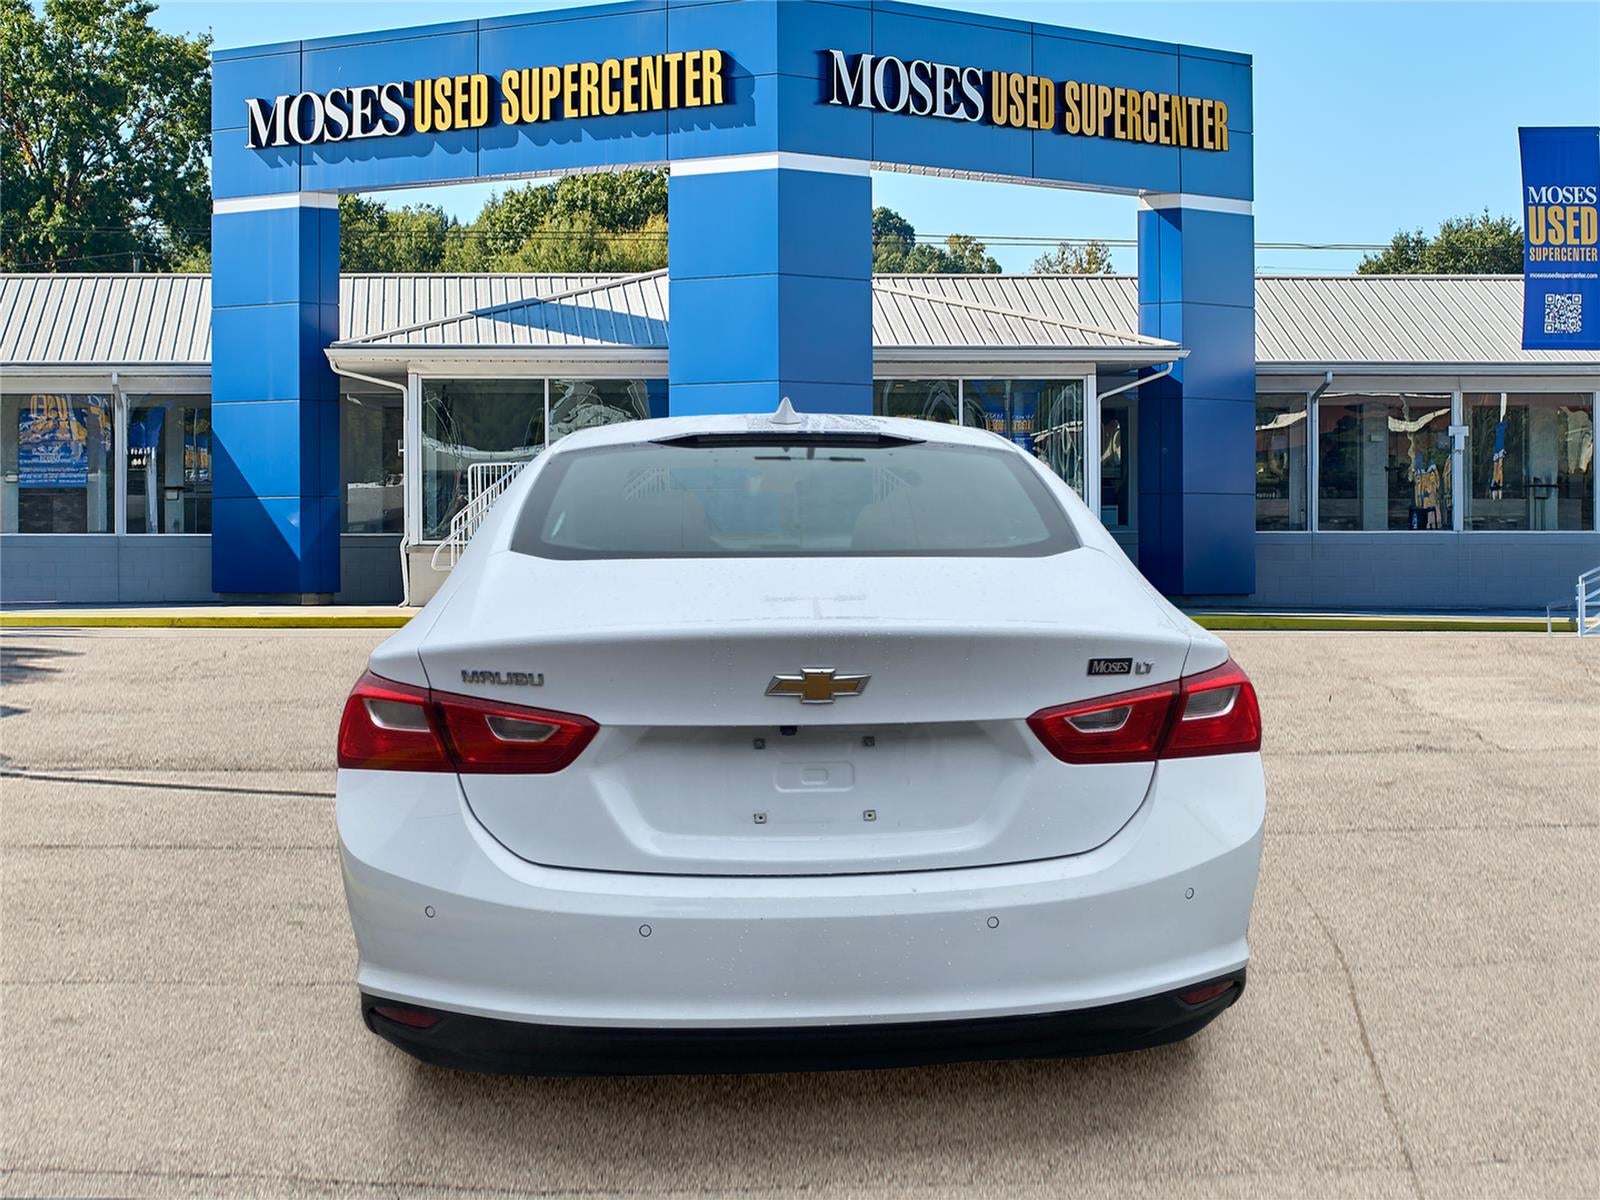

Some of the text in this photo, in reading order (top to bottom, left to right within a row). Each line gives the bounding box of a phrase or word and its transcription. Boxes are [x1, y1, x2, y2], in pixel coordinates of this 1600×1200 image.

[244, 49, 724, 149] MOSES USED SUPERCENTER
[828, 49, 1229, 151] MOSES USED SUPERCENTER
[1528, 186, 1597, 204] MOSES
[1528, 205, 1598, 245] USED
[1529, 247, 1598, 262] SUPERCENTER
[1134, 661, 1155, 675] LT
[460, 669, 545, 687] MALIBU
